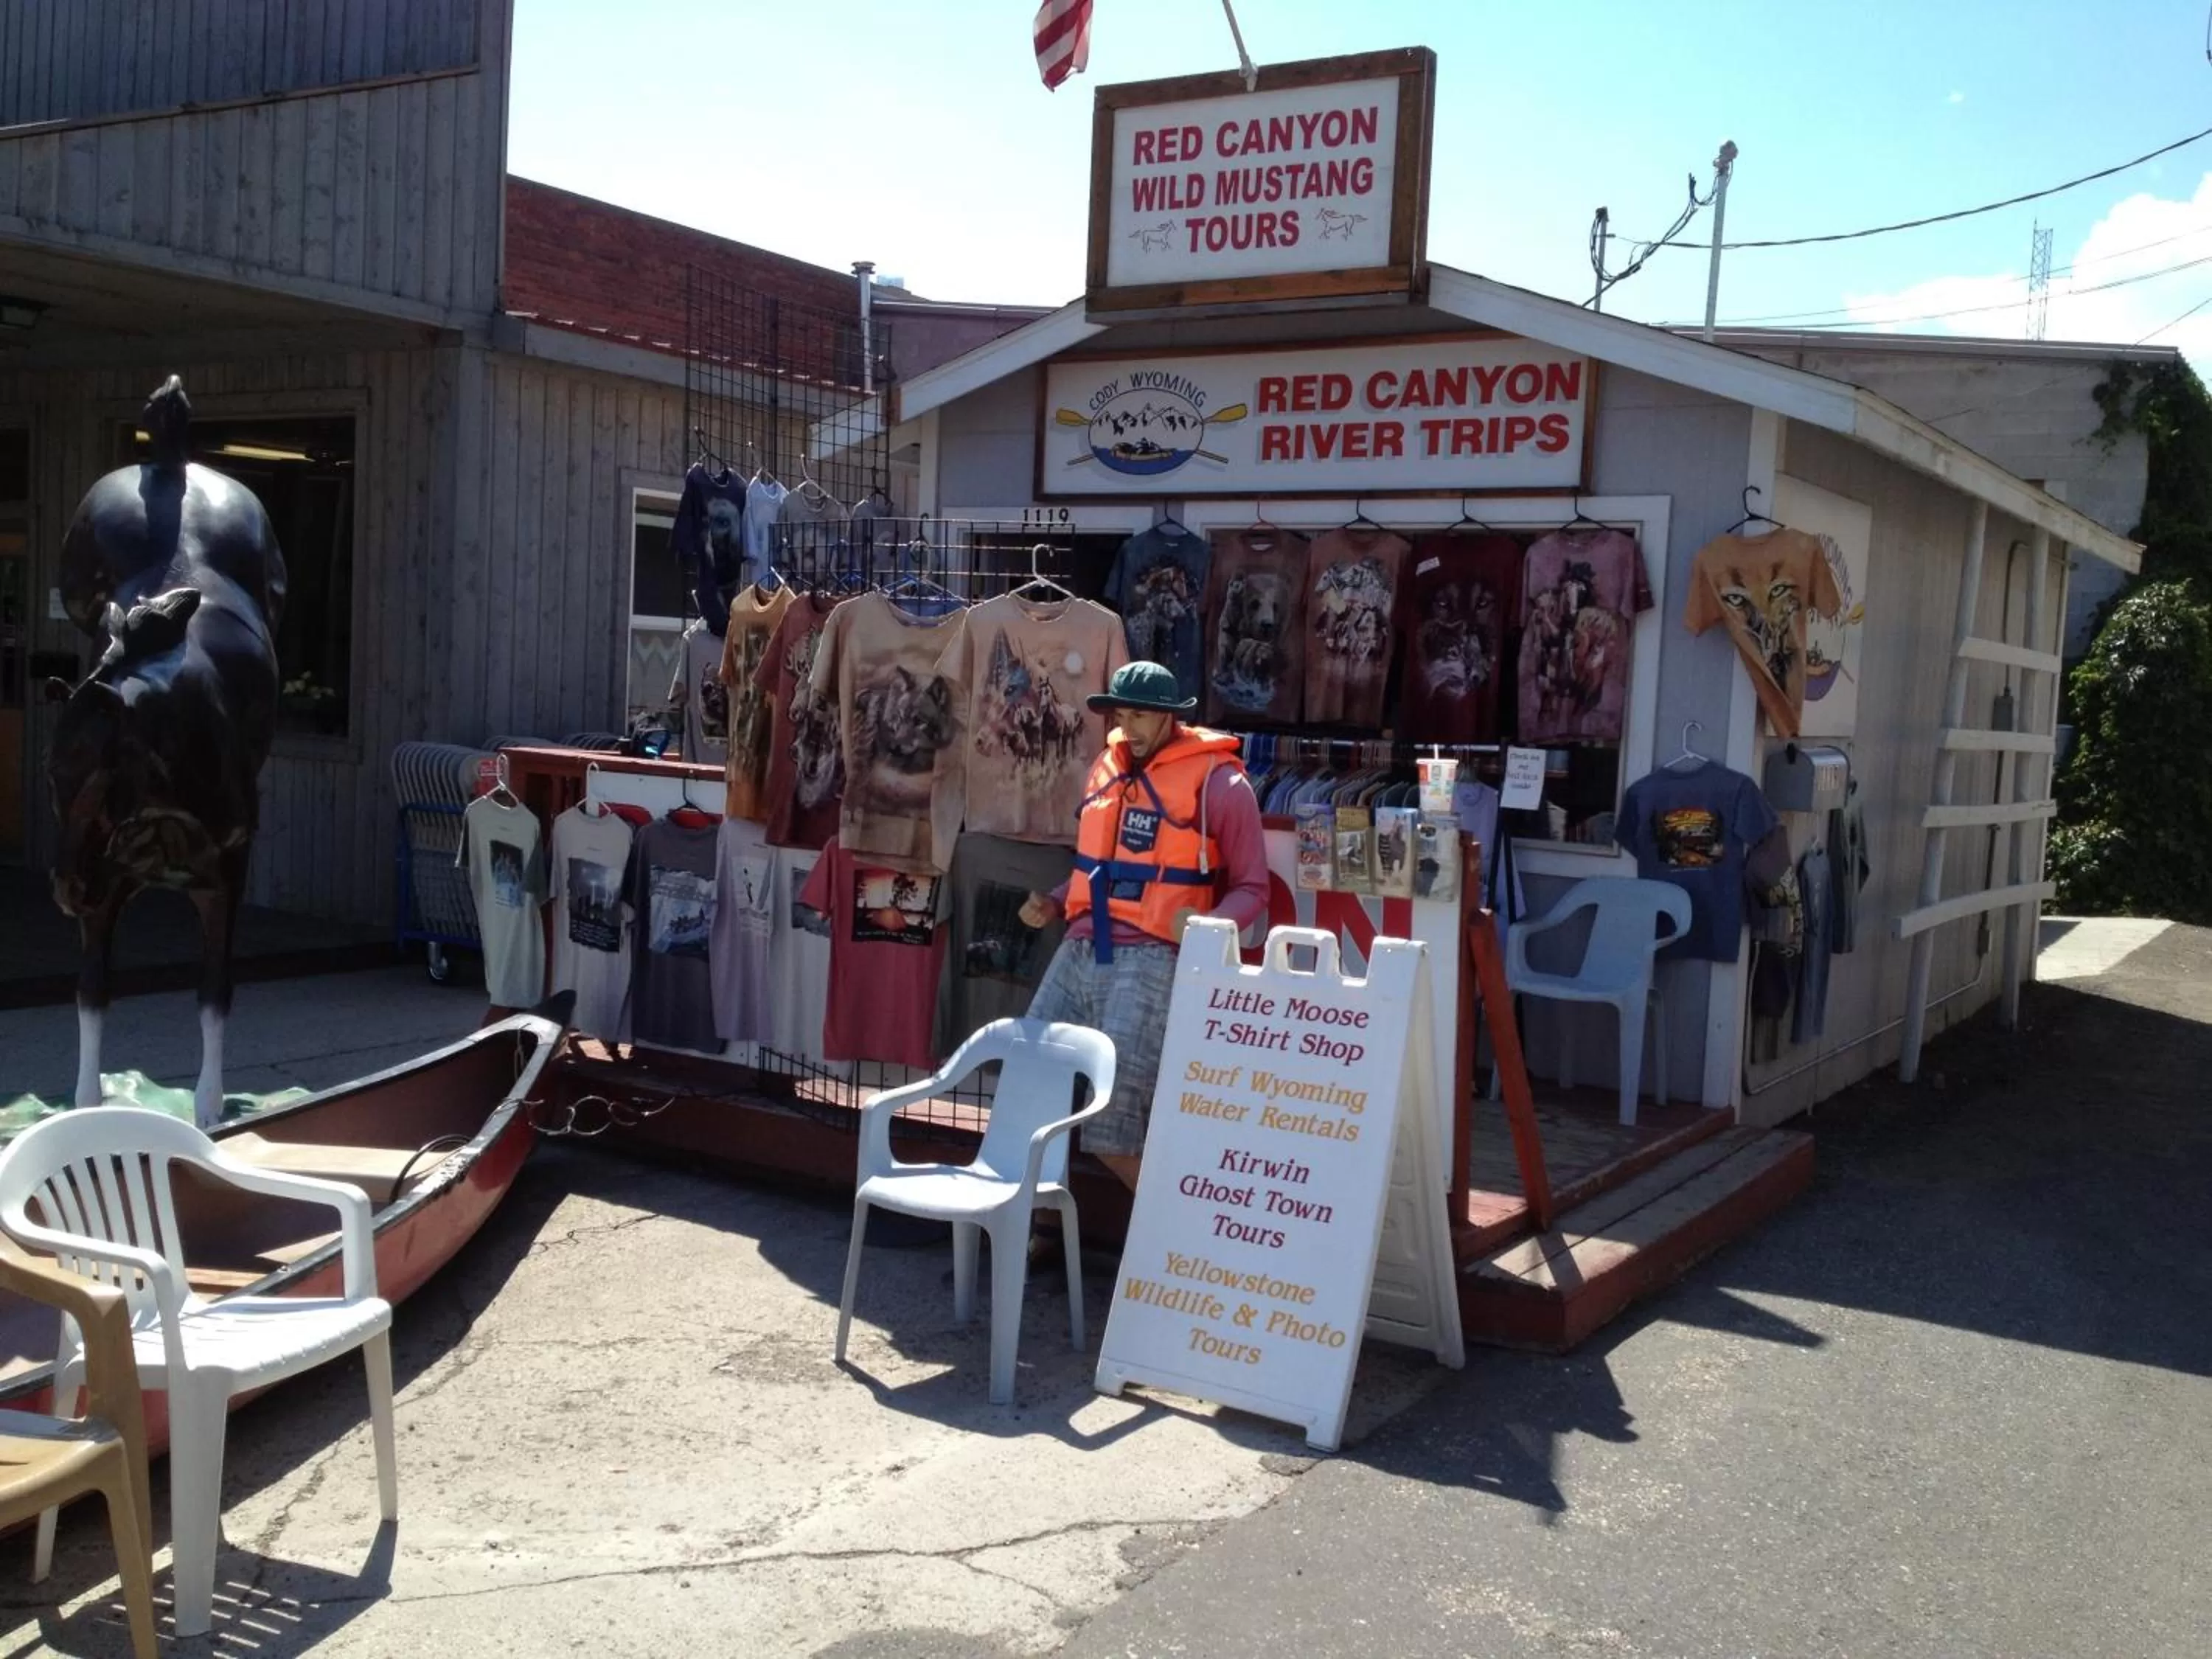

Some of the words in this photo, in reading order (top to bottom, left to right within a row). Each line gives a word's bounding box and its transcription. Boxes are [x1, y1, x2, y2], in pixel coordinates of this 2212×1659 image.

[1133, 126, 1203, 166] RED
[1216, 106, 1379, 157] CANYON
[1133, 173, 1205, 212] WILD
[1215, 156, 1374, 206] MUSTANG
[1185, 210, 1300, 253] TOURS
[1089, 379, 1119, 411] CODY
[1130, 371, 1208, 408] WYOMING
[1258, 375, 1353, 414] RED
[1366, 361, 1582, 409] CANYON
[1261, 422, 1404, 462] RIVER
[1420, 414, 1571, 456] TRIPS
[1023, 507, 1068, 523] 1119
[1127, 812, 1152, 830] HH
[1207, 988, 1276, 1016] Little
[1283, 997, 1370, 1029] Moose
[1204, 1019, 1291, 1051] T-Shirt
[1298, 1033, 1365, 1066] Shop
[1183, 1060, 1243, 1088] Surf
[1251, 1069, 1369, 1115] Wyoming
[1179, 1092, 1251, 1123] Water
[1259, 1105, 1360, 1141] Rentals
[1219, 1148, 1311, 1184] Kirwin
[1179, 1175, 1256, 1208] Ghost
[1265, 1190, 1333, 1223] Town
[1211, 1214, 1286, 1248] Tours
[1163, 1251, 1316, 1306] Yellowstone
[1124, 1277, 1225, 1321] Wildlife
[1232, 1303, 1259, 1329] &
[1266, 1310, 1346, 1349] Photo
[1187, 1328, 1262, 1366] Tours
